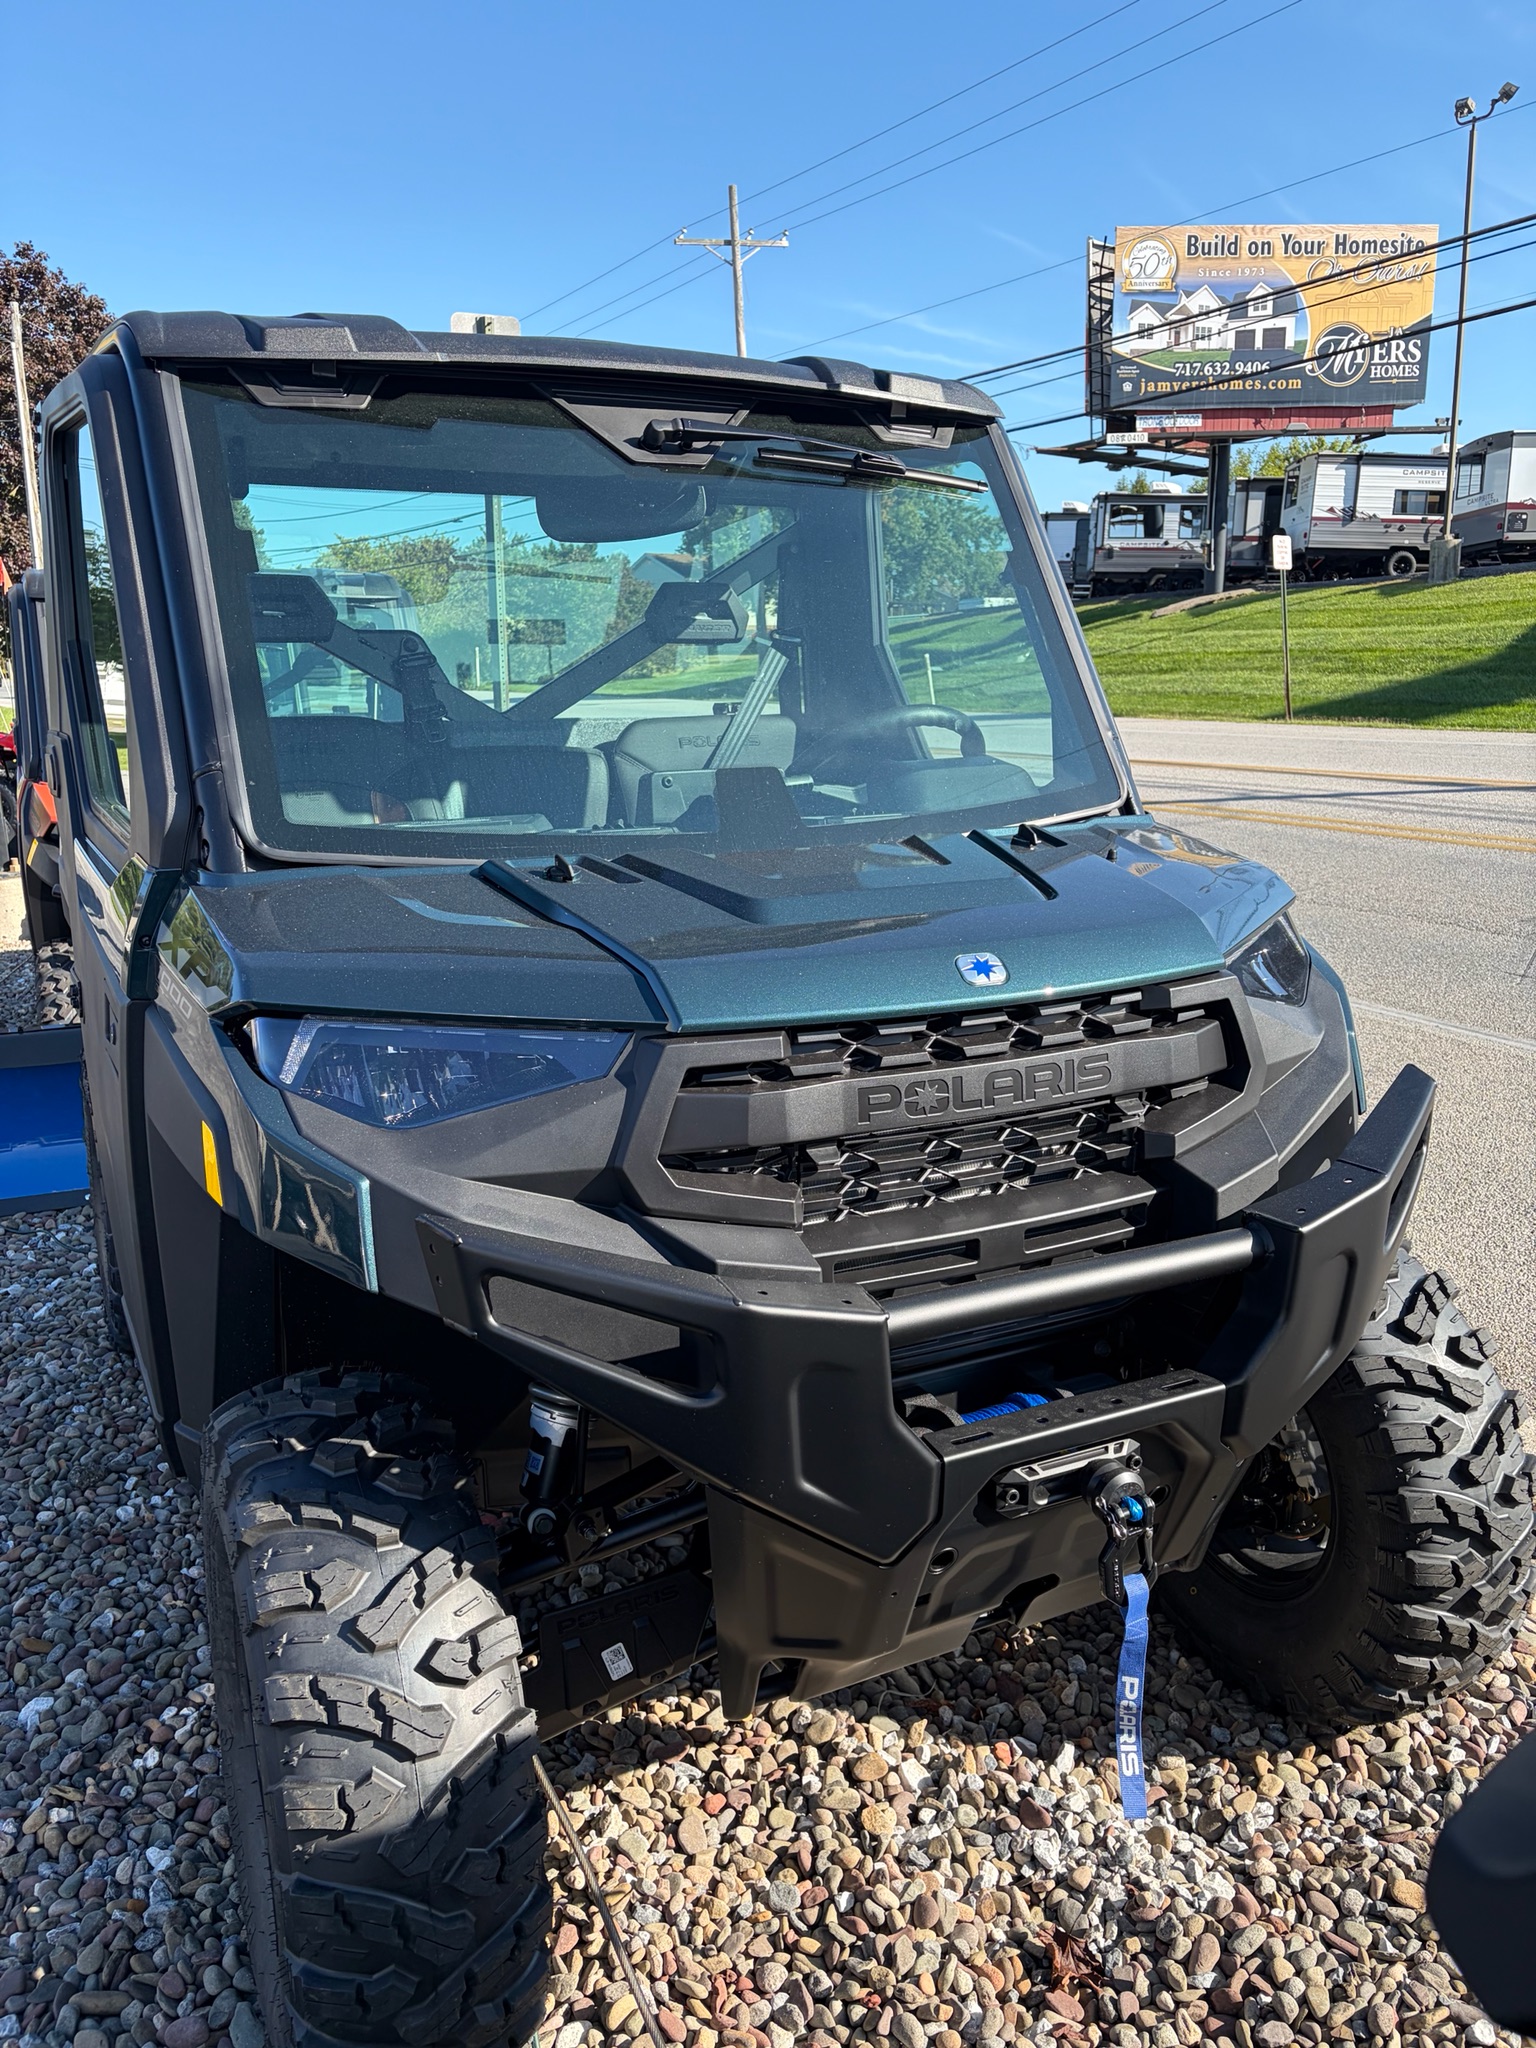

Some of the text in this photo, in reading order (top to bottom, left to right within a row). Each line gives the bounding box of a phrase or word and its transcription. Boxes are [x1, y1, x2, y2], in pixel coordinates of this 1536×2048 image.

[1186, 232, 1426, 256] Build on Your Homesite
[1129, 252, 1173, 278] 50th
[1198, 267, 1266, 277] Since 1973
[1128, 280, 1170, 288] Anniversary
[1305, 332, 1422, 375] MYERS
[1174, 361, 1271, 377] 717.632.9406
[1370, 364, 1420, 378] HOMES
[1466, 492, 1495, 506] CAMPSITE
[677, 734, 761, 749] POLS
[857, 1053, 1112, 1125] POLARIS
[556, 1583, 681, 1636] POLARIS
